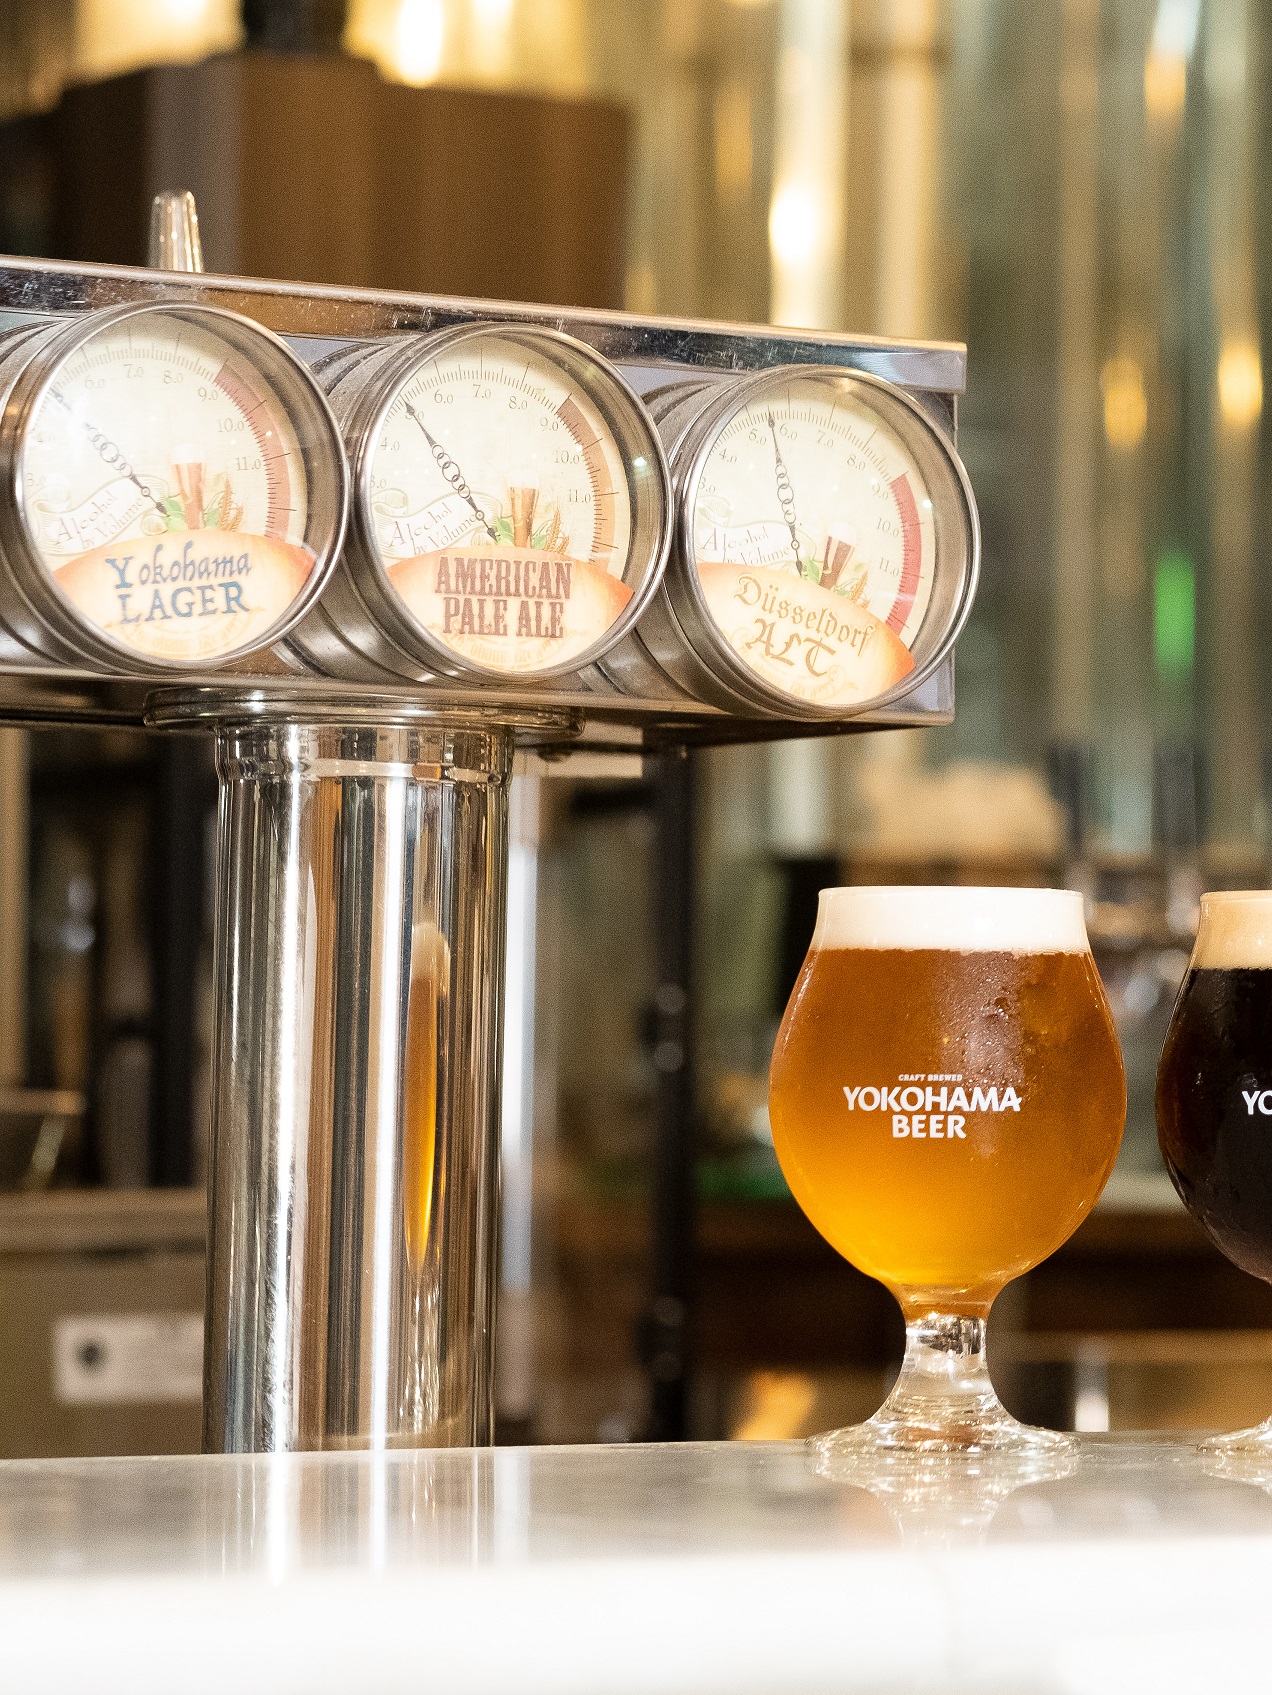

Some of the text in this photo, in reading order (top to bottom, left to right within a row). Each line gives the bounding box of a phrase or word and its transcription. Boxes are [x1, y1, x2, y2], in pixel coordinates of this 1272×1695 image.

[123, 363, 144, 379] 7.0
[162, 370, 184, 385] 8.0
[197, 386, 219, 402] 9.0
[434, 388, 455, 405] 6.0
[472, 384, 492, 400] 7.0
[508, 395, 528, 410] 8.0
[217, 418, 246, 433] 10.0
[540, 417, 559, 433] 9.0
[778, 422, 798, 441] 6.0
[380, 436, 400, 452] 4.0
[748, 427, 767, 446] 5.0
[816, 429, 835, 448] 7.0
[236, 457, 262, 472] 11.0
[553, 449, 581, 465] 10.0
[717, 446, 738, 465] 4.0
[846, 454, 867, 471] 8.0
[567, 489, 592, 504] 11.0
[871, 483, 890, 501] 9.0
[55, 490, 117, 545] Alcohol
[388, 501, 452, 548] Alcohol
[876, 516, 901, 538] 10.0
[427, 514, 478, 549] Volume
[105, 540, 253, 589] Yokohama
[878, 556, 901, 578] 11.0
[435, 556, 573, 600] AMERICAN
[117, 581, 251, 625] LAGER
[442, 597, 565, 639] PALE ALE
[734, 575, 875, 657] Düsseldorf
[745, 617, 837, 678] ALT
[898, 1074, 963, 1082] CRAFT BREWED
[842, 1086, 1023, 1112] YOKOHAMA
[892, 1114, 967, 1139] BEER
